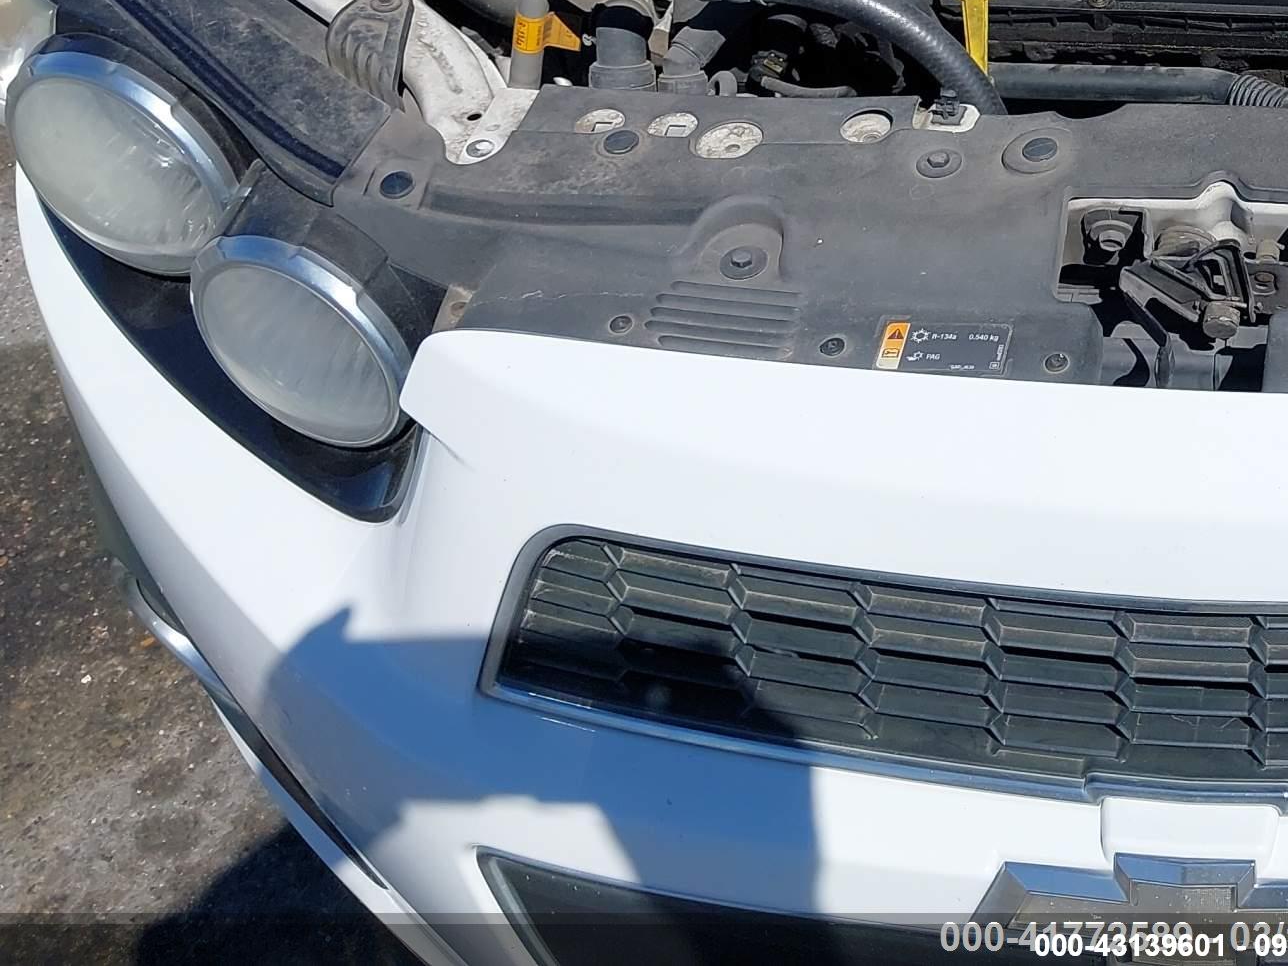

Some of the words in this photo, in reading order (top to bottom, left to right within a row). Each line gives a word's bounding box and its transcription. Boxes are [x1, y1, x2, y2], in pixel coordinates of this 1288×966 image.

[931, 333, 957, 341] R-134a
[968, 333, 989, 341] 0.540
[989, 334, 1000, 343] kg
[925, 353, 941, 361] PAG
